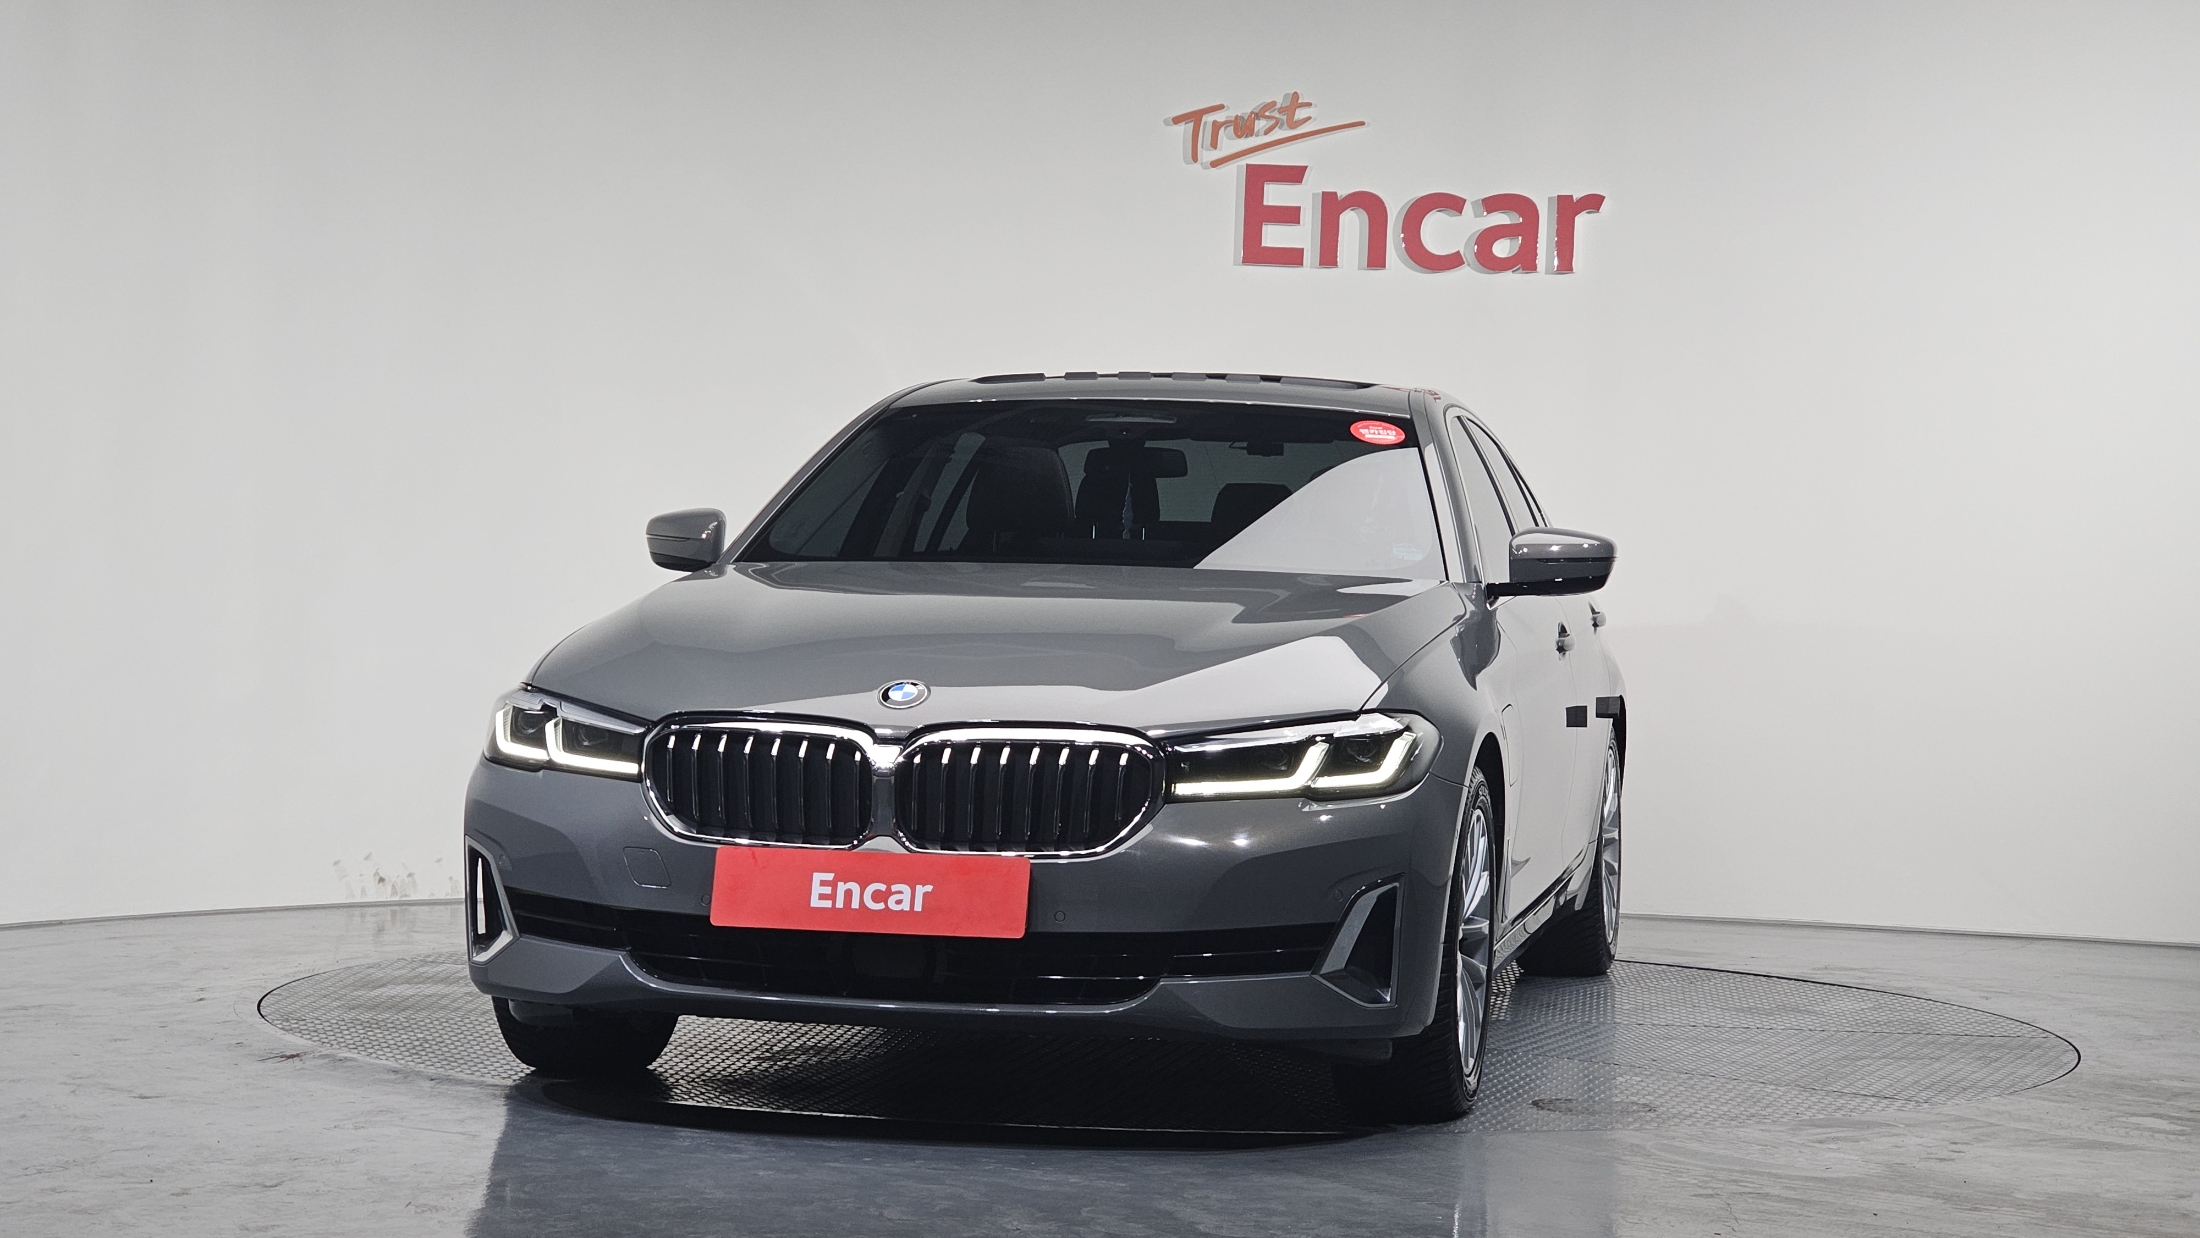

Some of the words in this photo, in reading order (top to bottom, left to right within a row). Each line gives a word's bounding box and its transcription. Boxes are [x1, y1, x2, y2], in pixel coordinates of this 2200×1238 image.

[1172, 91, 1313, 163] Trust
[1240, 163, 1606, 274] Encar
[810, 872, 933, 912] Encar
